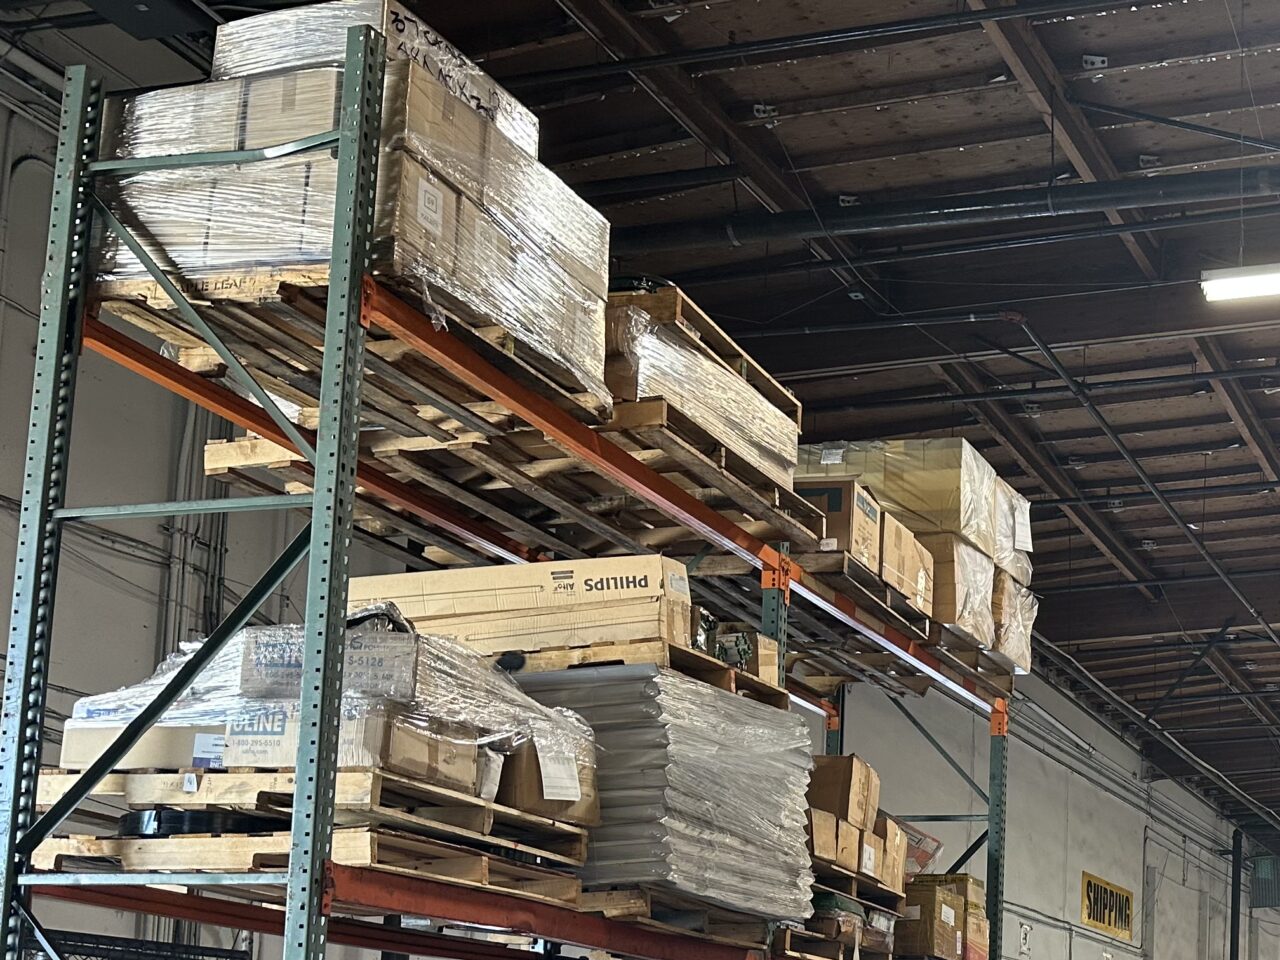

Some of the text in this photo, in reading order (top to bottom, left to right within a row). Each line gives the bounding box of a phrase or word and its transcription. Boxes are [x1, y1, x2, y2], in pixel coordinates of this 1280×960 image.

[584, 575, 649, 592] PHILIPS
[232, 711, 283, 732] ULINE
[1086, 879, 1131, 931] SHIPPING
